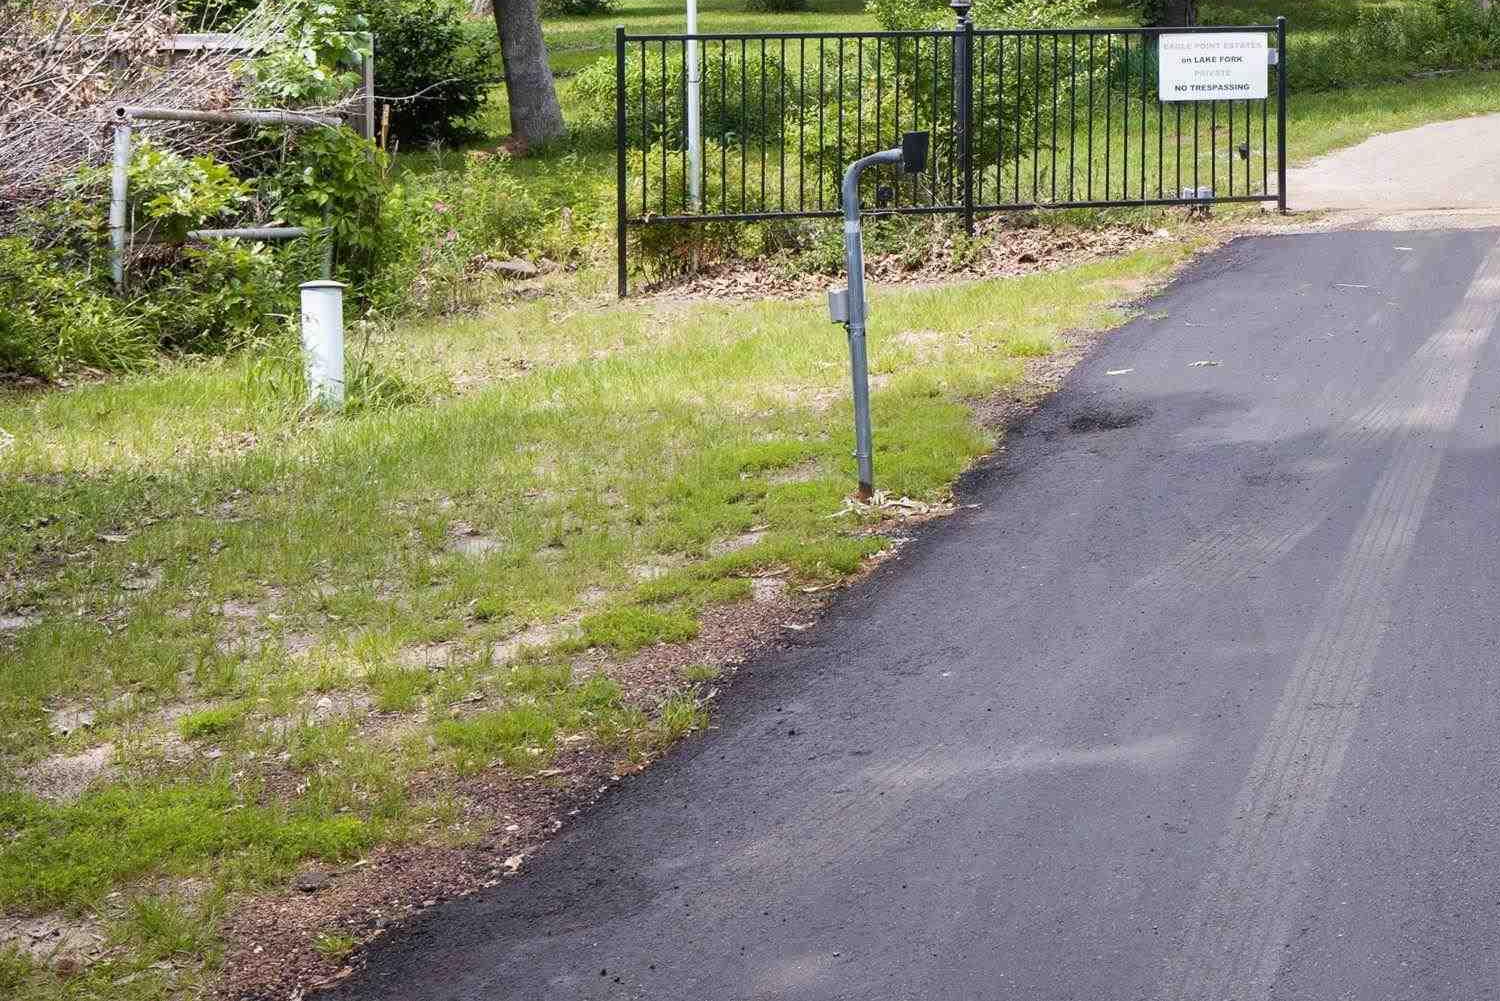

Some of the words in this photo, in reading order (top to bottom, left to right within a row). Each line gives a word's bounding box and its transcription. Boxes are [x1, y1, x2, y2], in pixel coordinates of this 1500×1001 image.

[1223, 39, 1264, 49] ESTATES
[1194, 56, 1217, 64] LAKE
[1219, 55, 1243, 63] FORK
[1194, 69, 1233, 77] PRIVATE
[1174, 84, 1188, 92] NO
[1189, 83, 1250, 92] TRESPASSING
